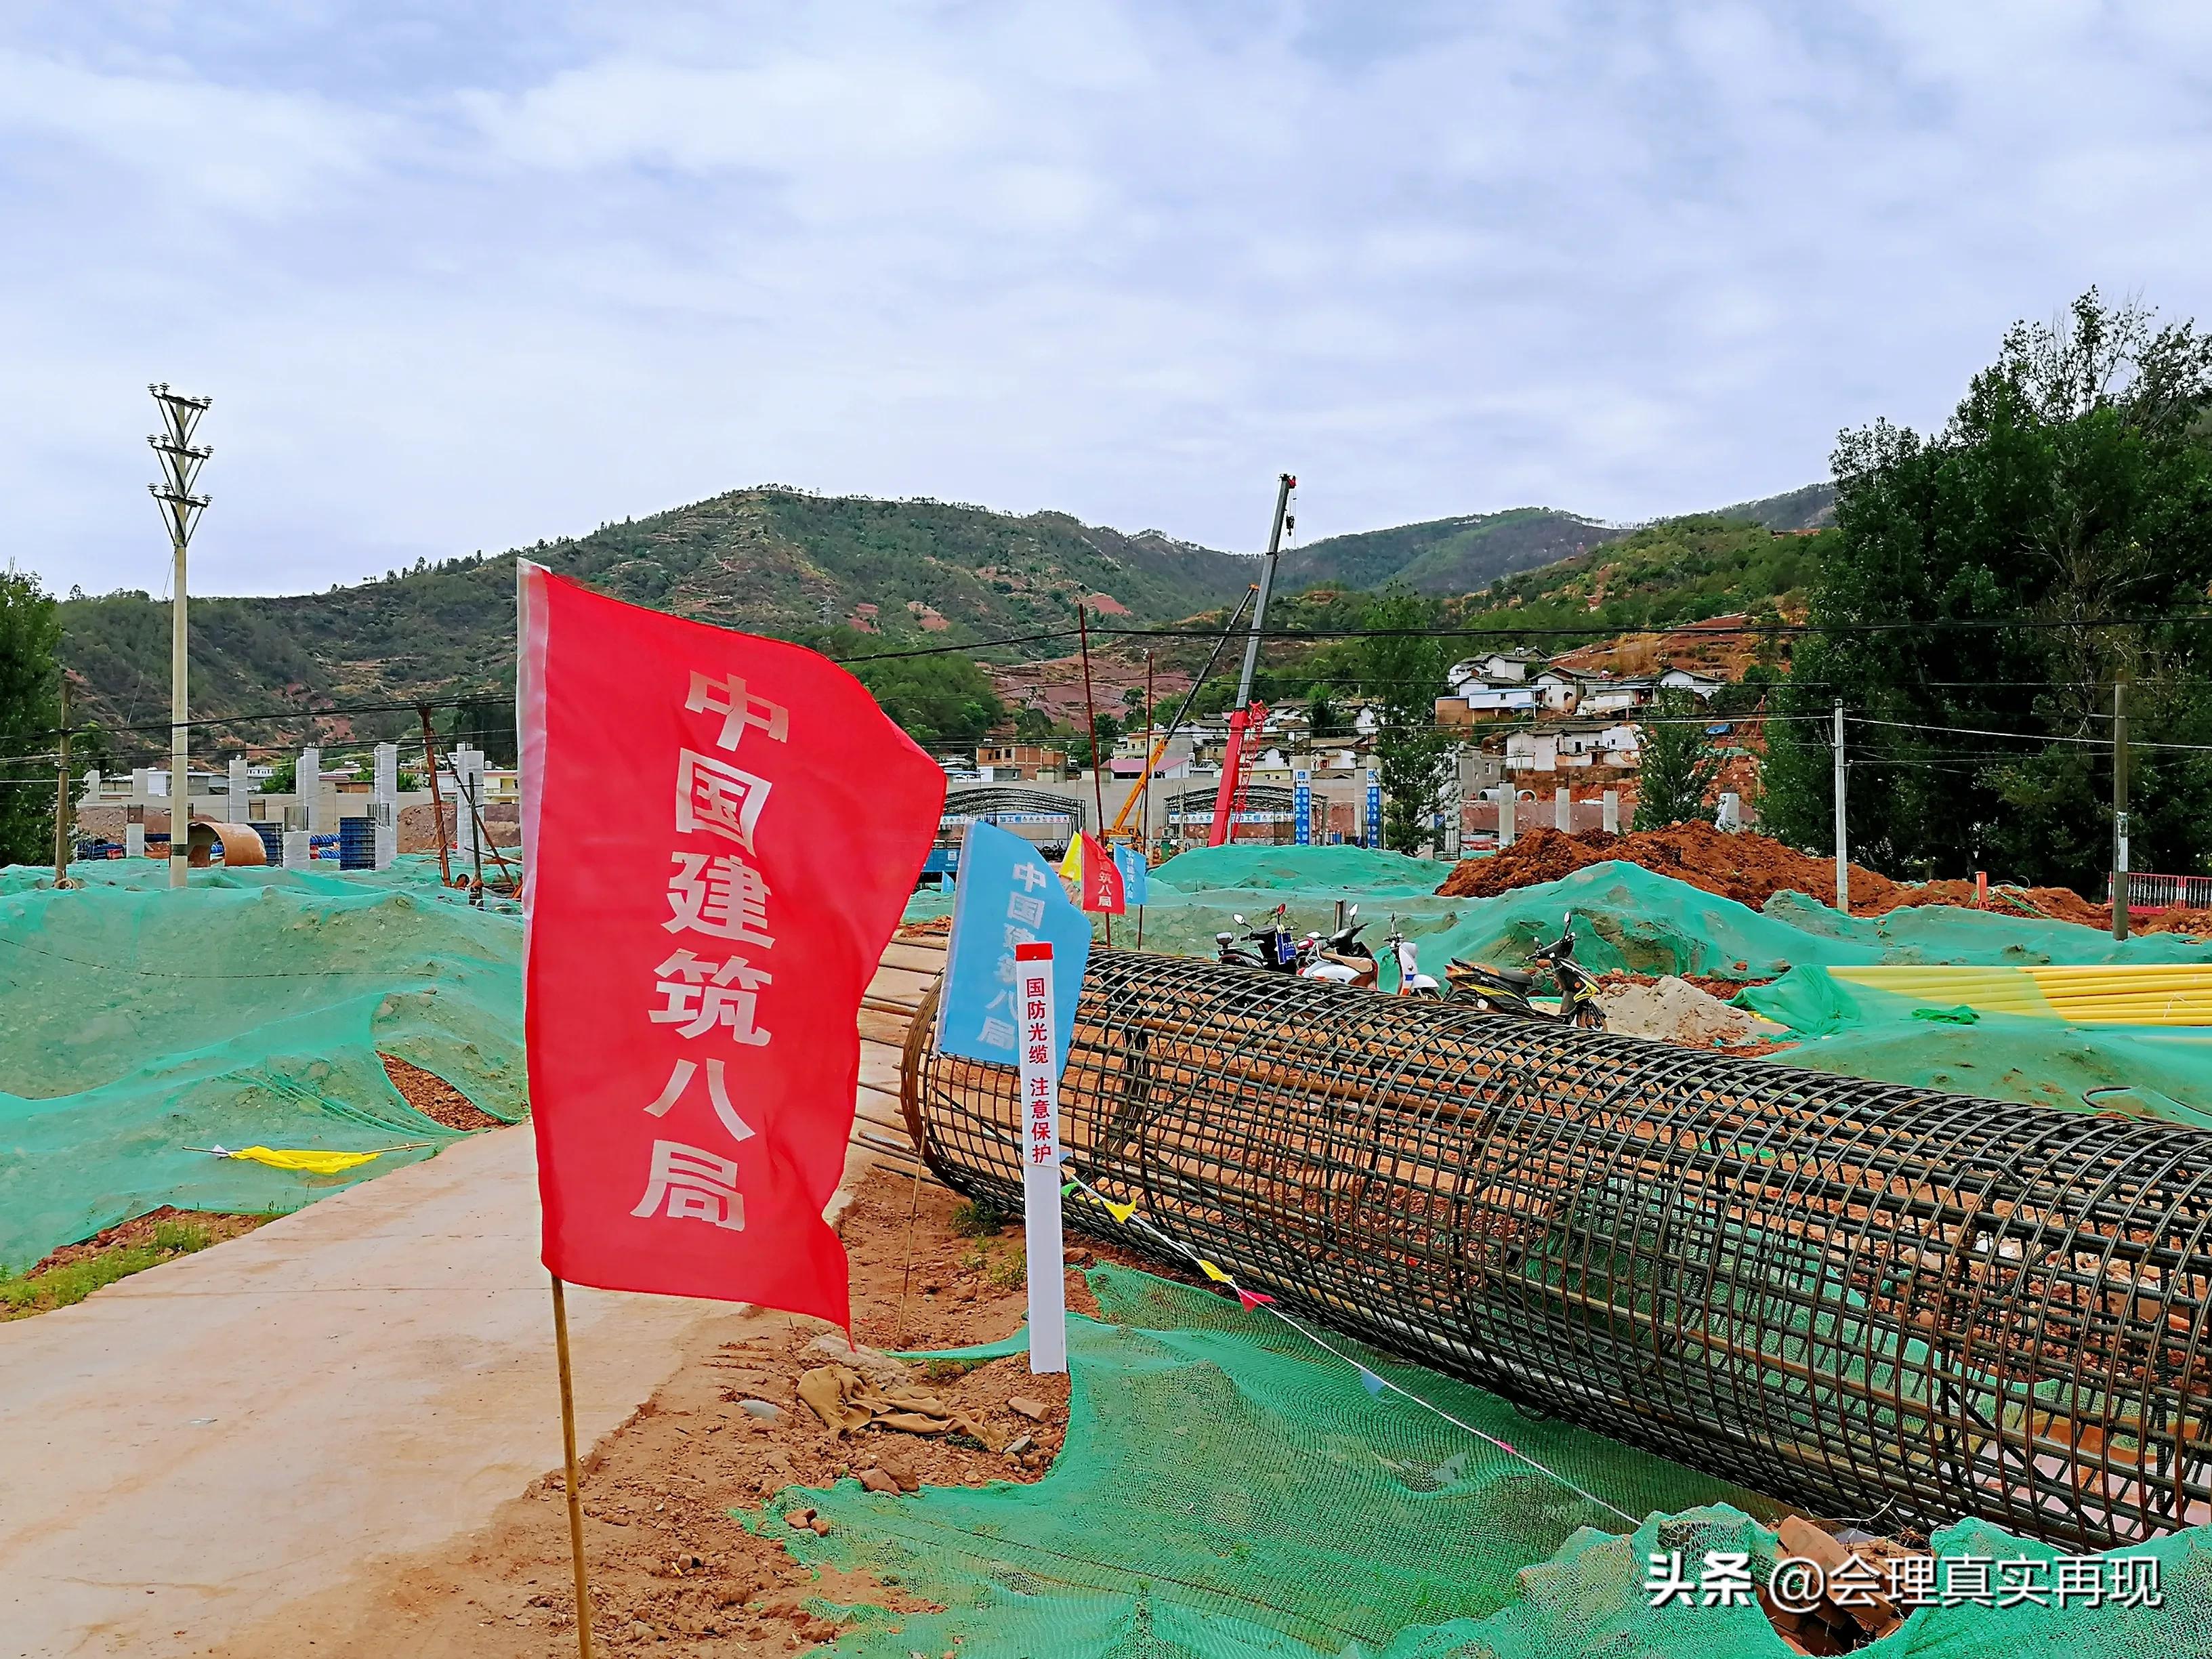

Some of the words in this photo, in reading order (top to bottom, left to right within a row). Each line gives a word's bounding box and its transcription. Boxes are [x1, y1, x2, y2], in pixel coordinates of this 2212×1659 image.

[630, 669, 789, 1232] 中国建筑八局
[1026, 978, 1049, 1064] 国防光缆
[1029, 1076, 1052, 1164] 注意保护
